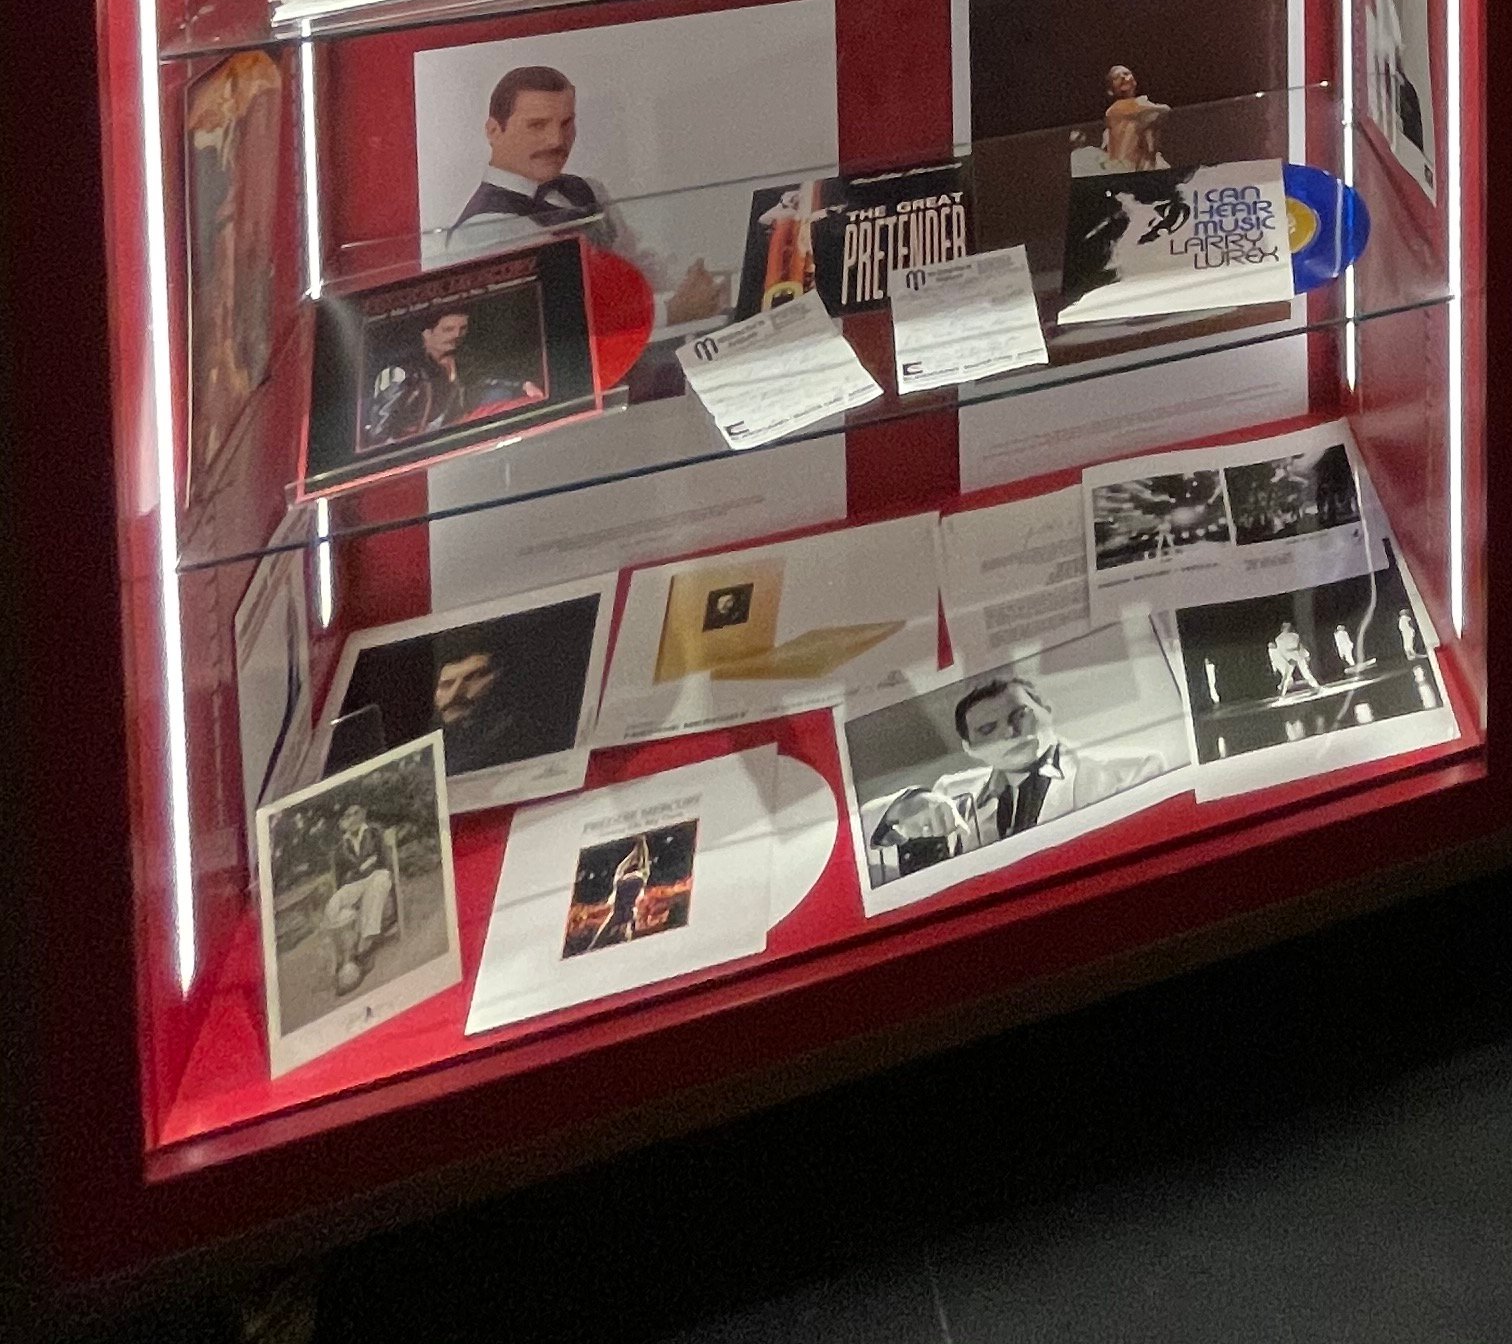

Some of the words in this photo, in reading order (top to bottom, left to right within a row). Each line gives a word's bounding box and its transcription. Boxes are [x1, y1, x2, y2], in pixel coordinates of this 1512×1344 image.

[846, 204, 888, 221] THE
[896, 191, 964, 213] GREAT
[1203, 185, 1261, 203] CAN
[1193, 200, 1273, 220] HEAR
[1194, 214, 1276, 236] MUSIC
[841, 204, 967, 305] PRETENDER
[1170, 231, 1264, 255] LARRY
[1194, 246, 1280, 270] LUREX
